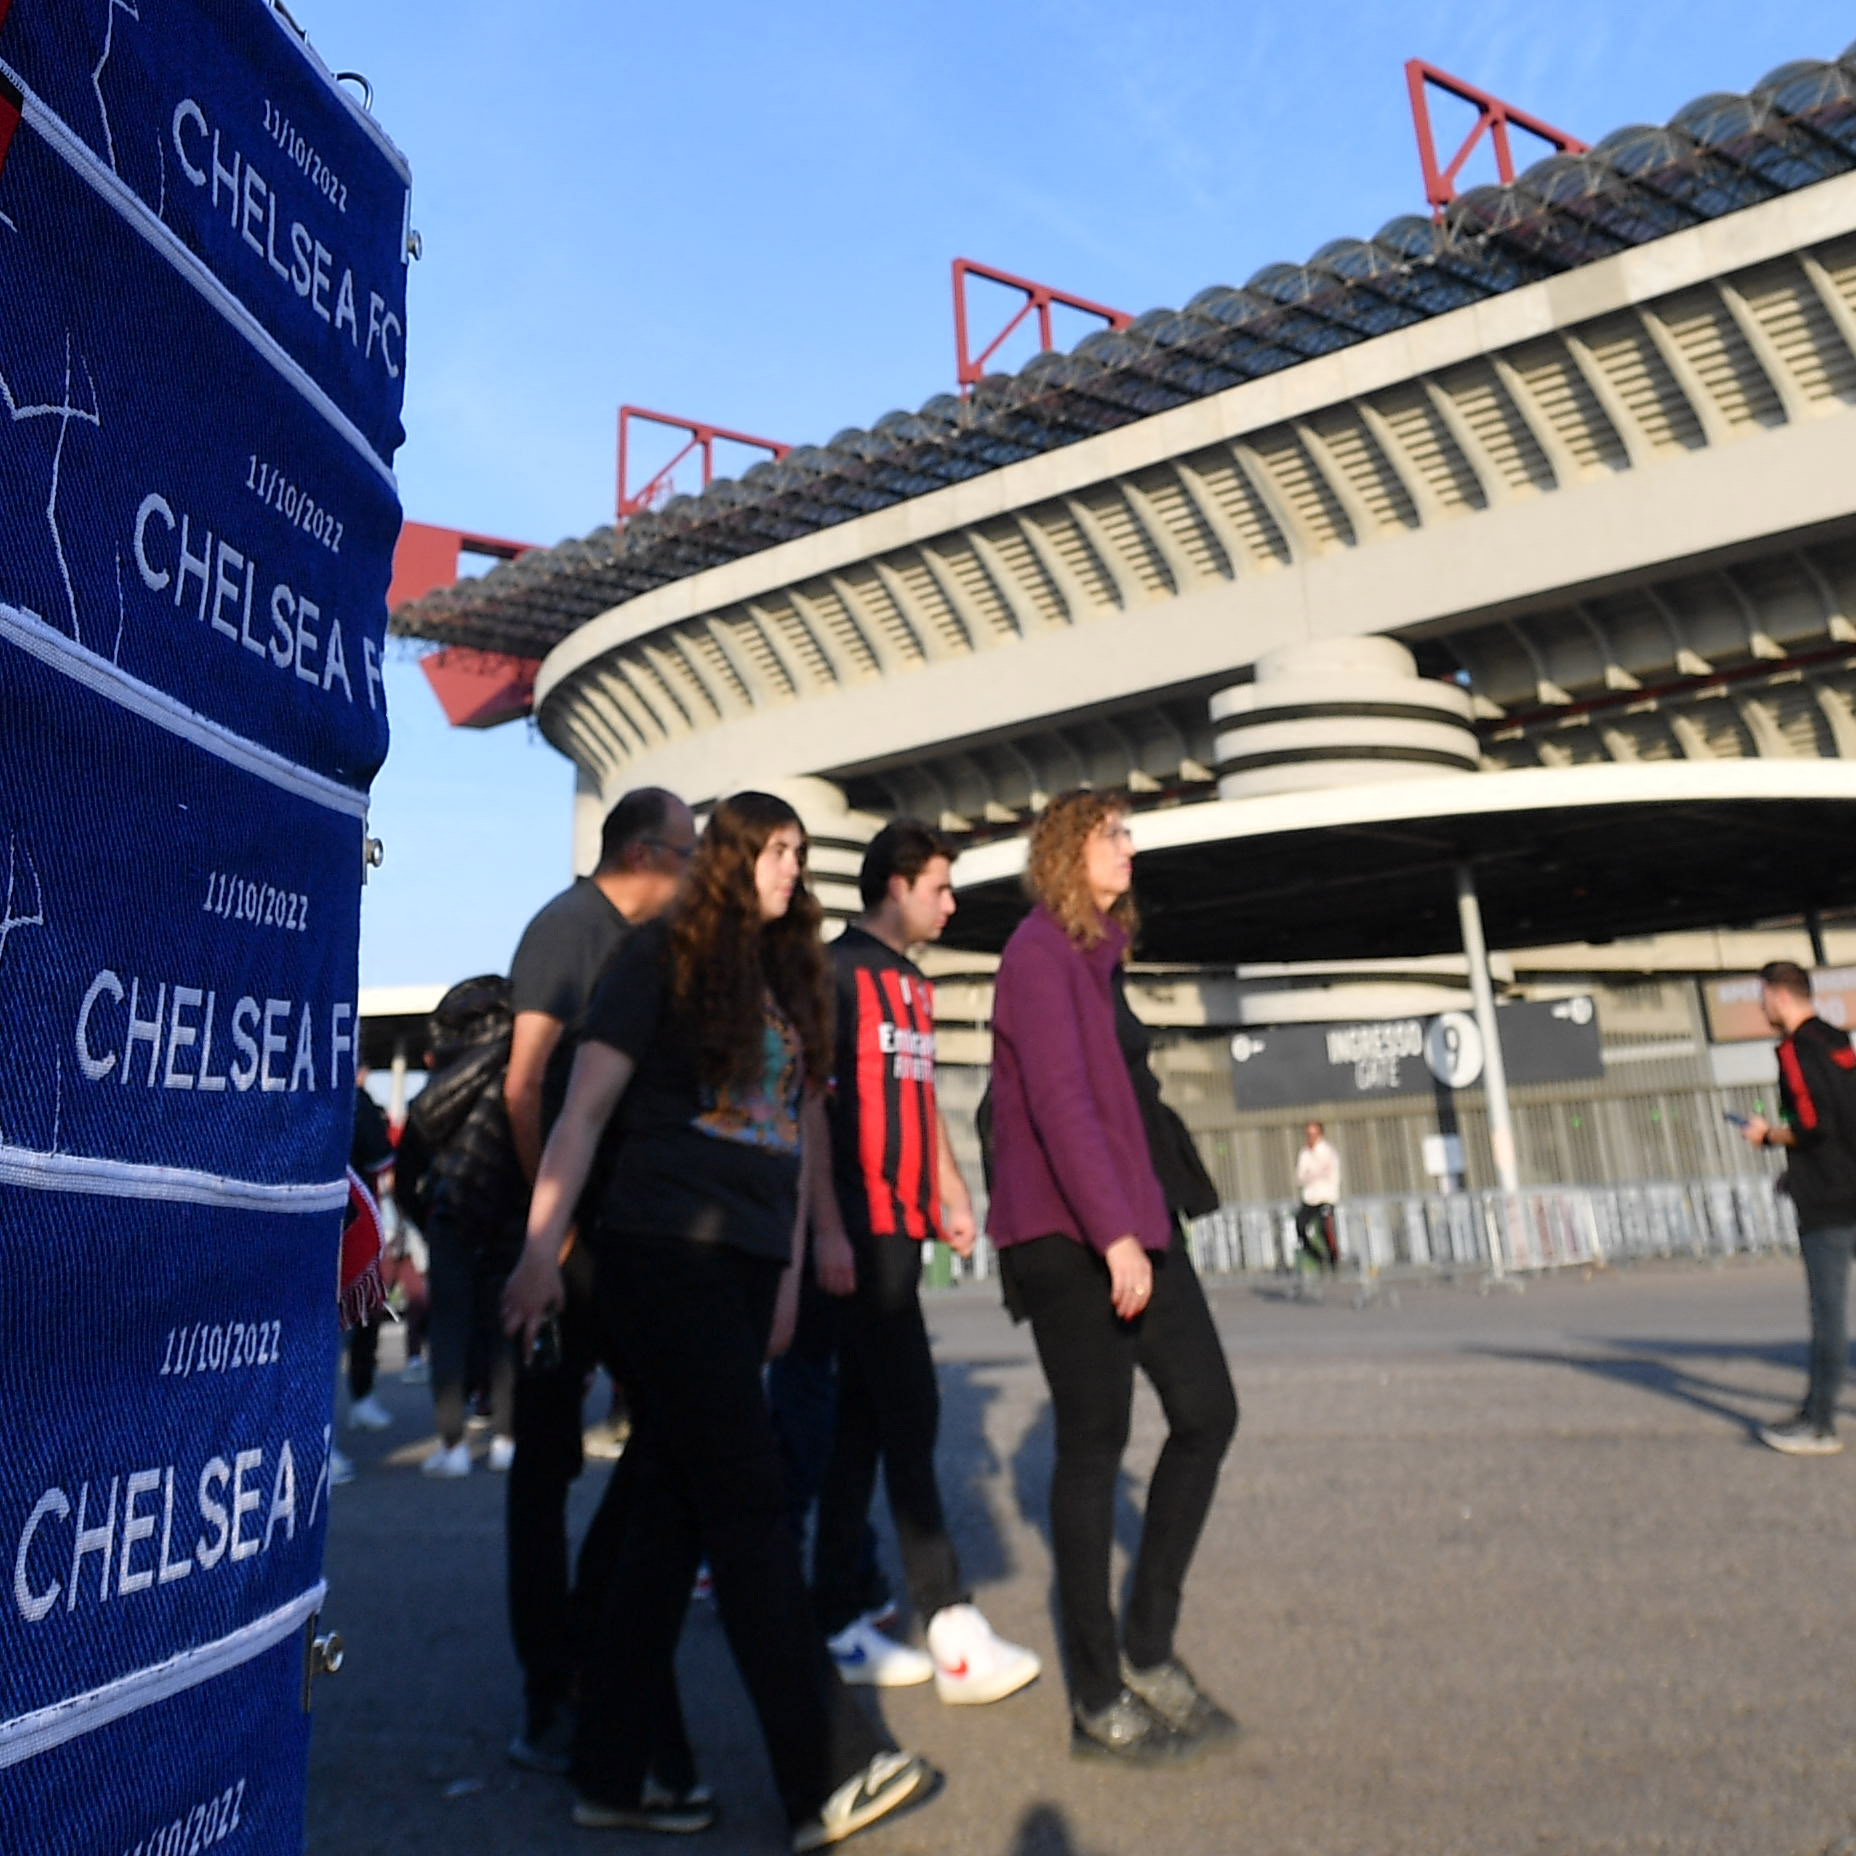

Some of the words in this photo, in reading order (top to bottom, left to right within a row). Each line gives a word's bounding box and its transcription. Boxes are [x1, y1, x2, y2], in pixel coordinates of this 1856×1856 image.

[263, 100, 347, 212] 11/10/2022
[173, 99, 357, 346] CHELSEA
[366, 292, 401, 378] FC
[246, 455, 343, 552] 11/10/2022
[134, 493, 352, 703] CHELSEA
[364, 637, 388, 709] F
[204, 872, 307, 931] 11/10/2022
[76, 969, 315, 1092] CHELSEA
[332, 1003, 359, 1088] F
[160, 1320, 280, 1377] 11/10/2022
[14, 1440, 295, 1622] CHELSEA
[124, 1778, 245, 1856] /10/2022
